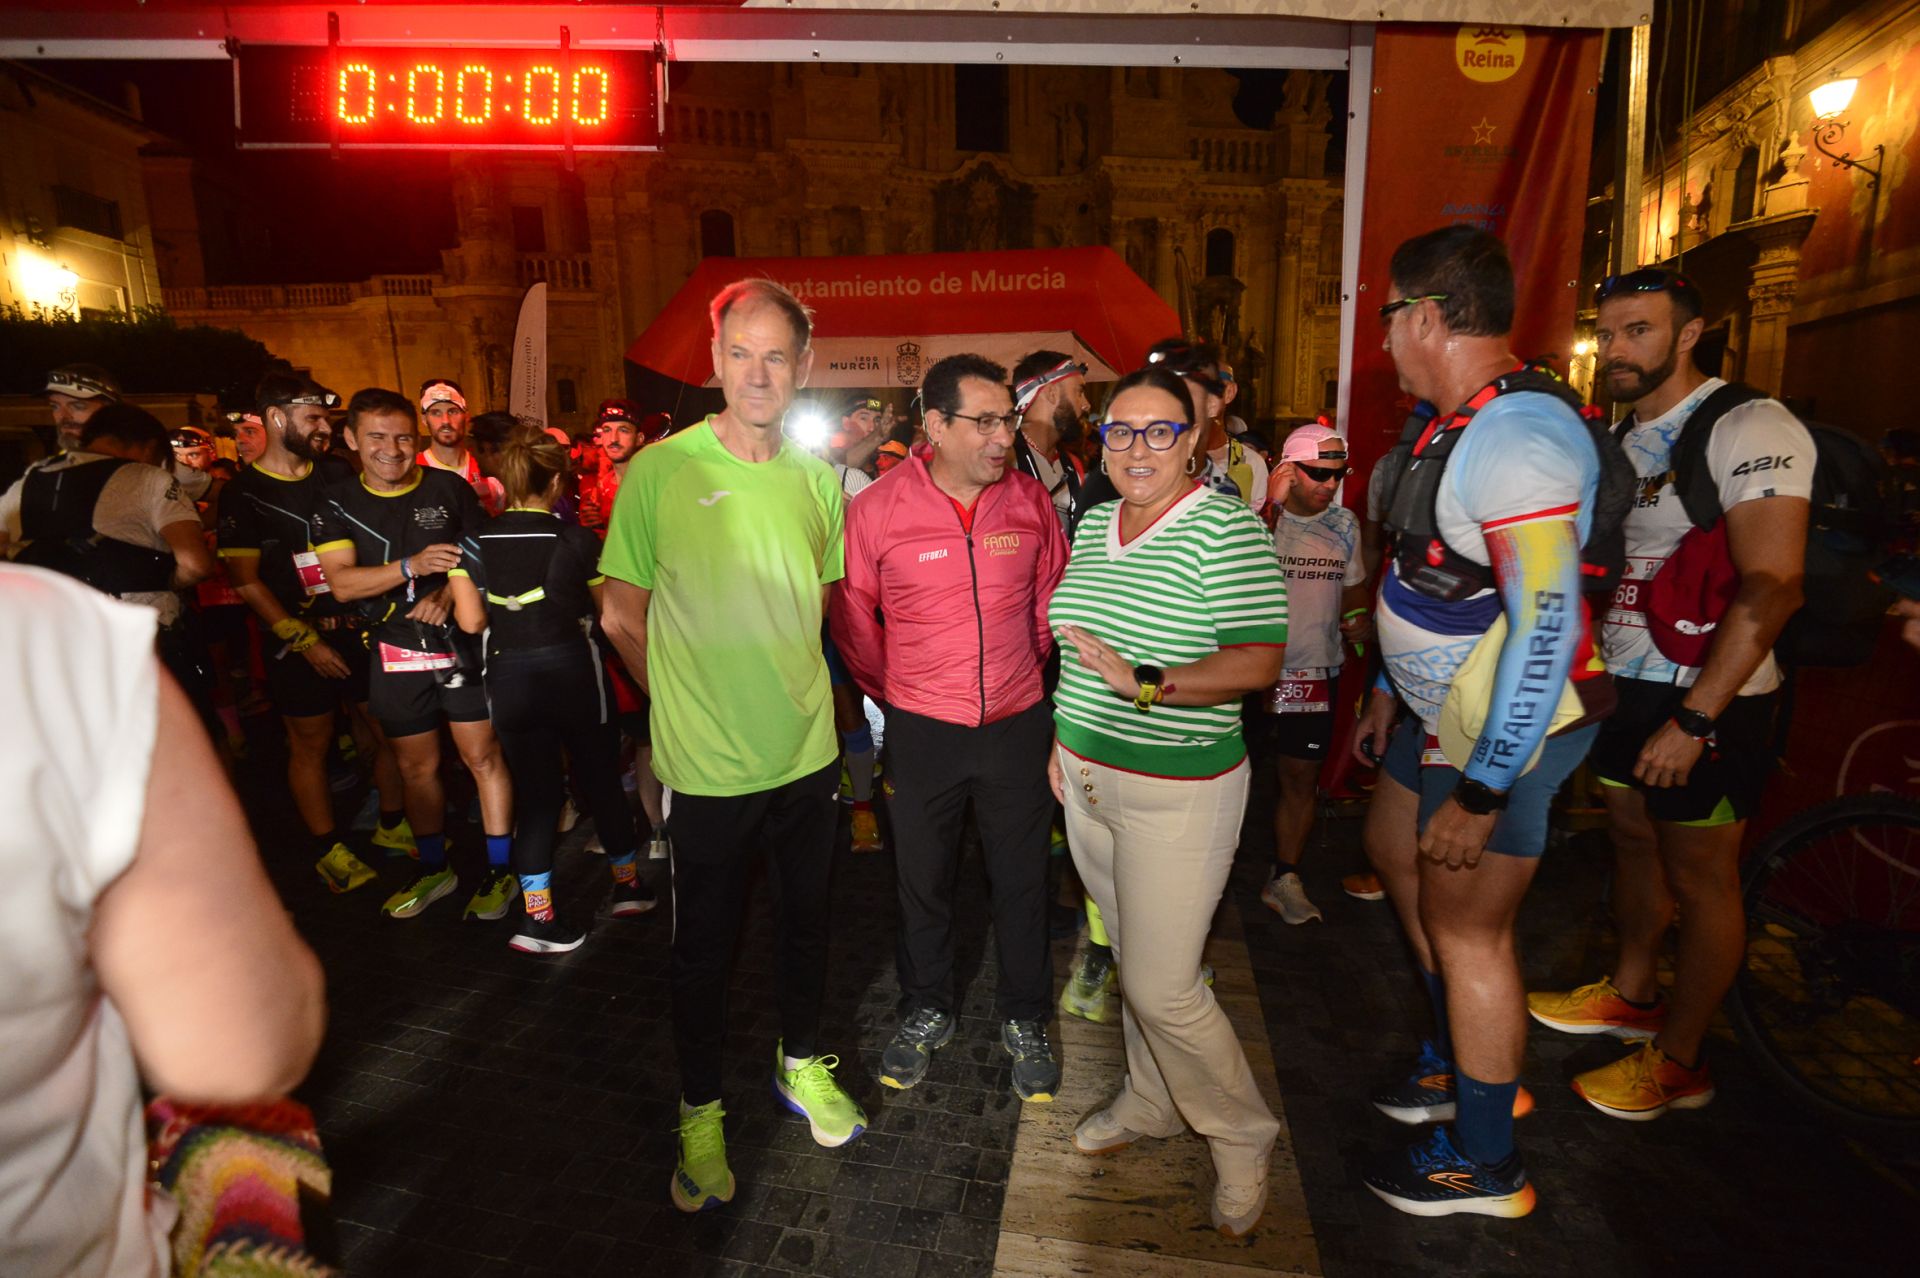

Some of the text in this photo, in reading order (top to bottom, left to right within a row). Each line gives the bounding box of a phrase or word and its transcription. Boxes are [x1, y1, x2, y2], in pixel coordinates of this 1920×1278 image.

[1463, 49, 1516, 69] Reina
[338, 64, 608, 125] 0:00:00
[783, 267, 1067, 299] ntamiento de Murcia
[830, 362, 880, 370] MURCIA
[1731, 456, 1795, 478] 42K
[919, 548, 949, 563] EFFORZA
[1297, 571, 1344, 582] USHER
[1486, 590, 1565, 770] TRACTORES
[1281, 683, 1314, 699] 367
